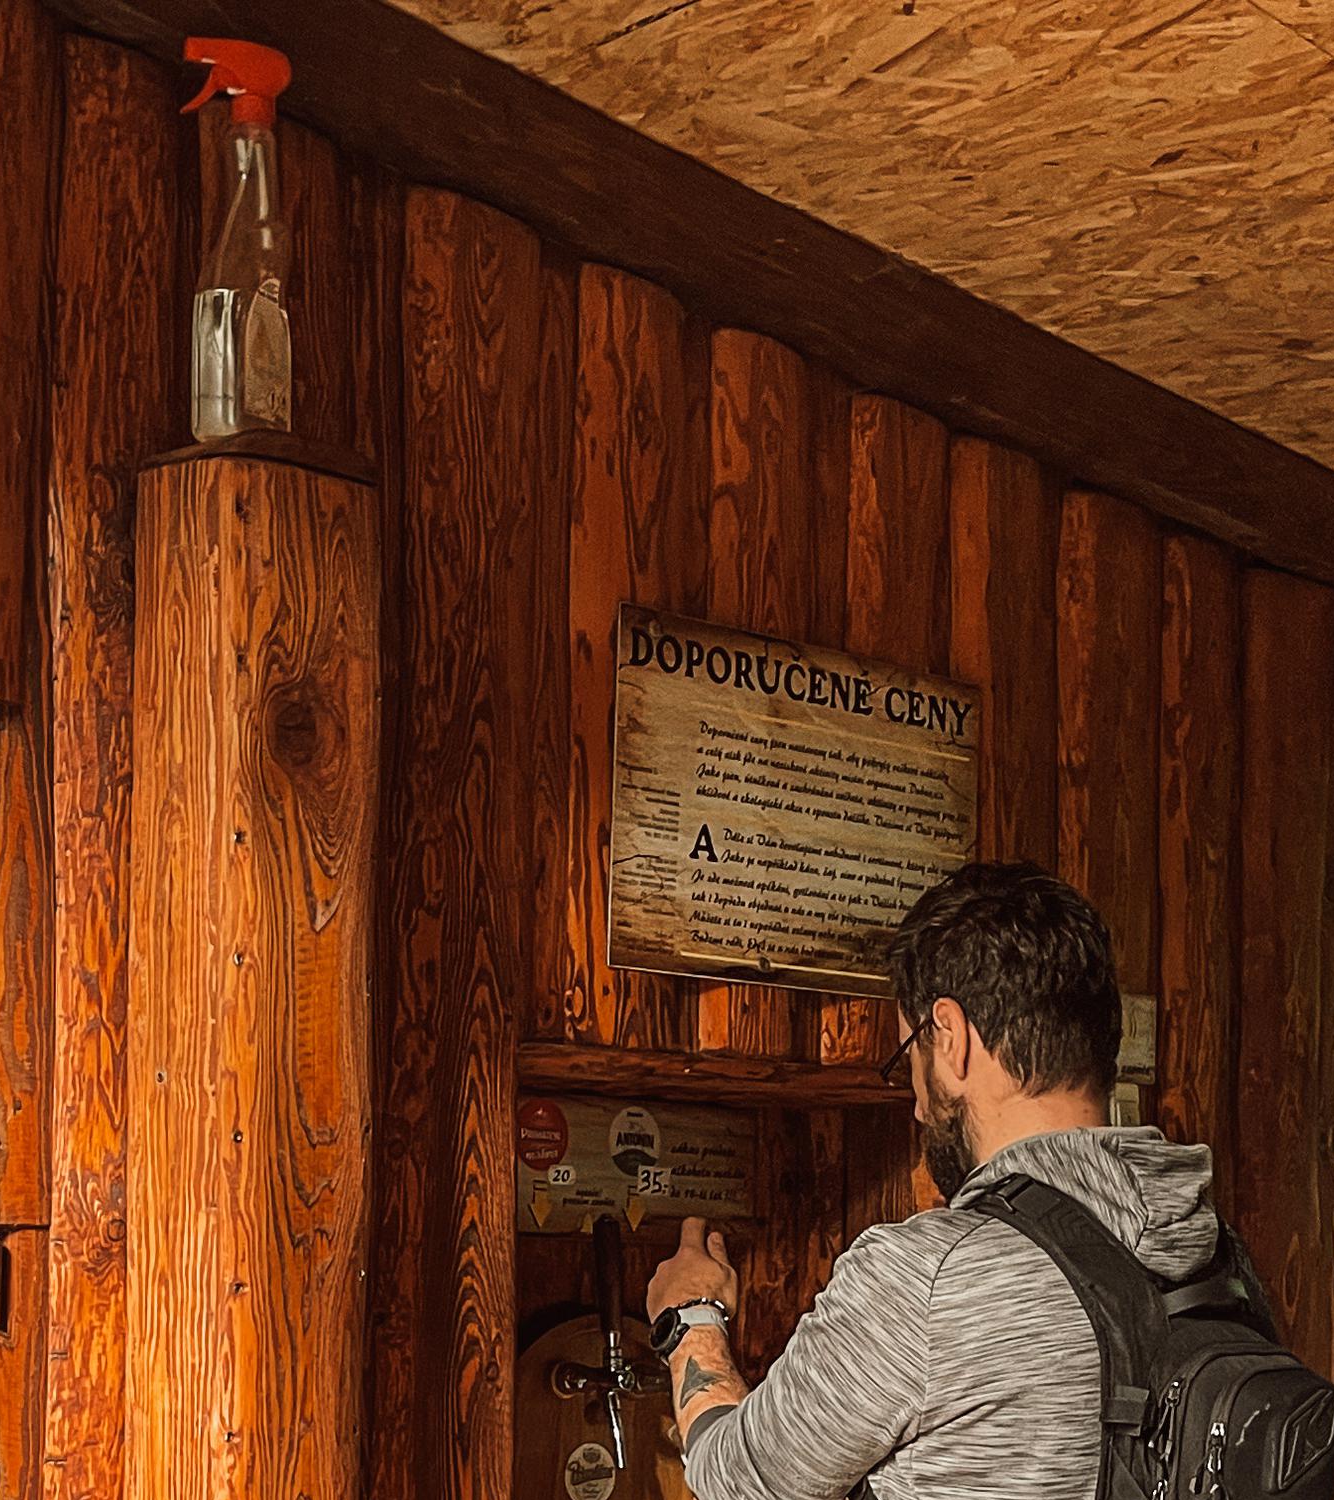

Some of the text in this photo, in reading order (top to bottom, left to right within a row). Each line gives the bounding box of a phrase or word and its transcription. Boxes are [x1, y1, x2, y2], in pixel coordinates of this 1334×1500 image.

[630, 627, 972, 736] DOPORUČENÉ CENY
[688, 823, 719, 862] A
[553, 1169, 571, 1183] 20
